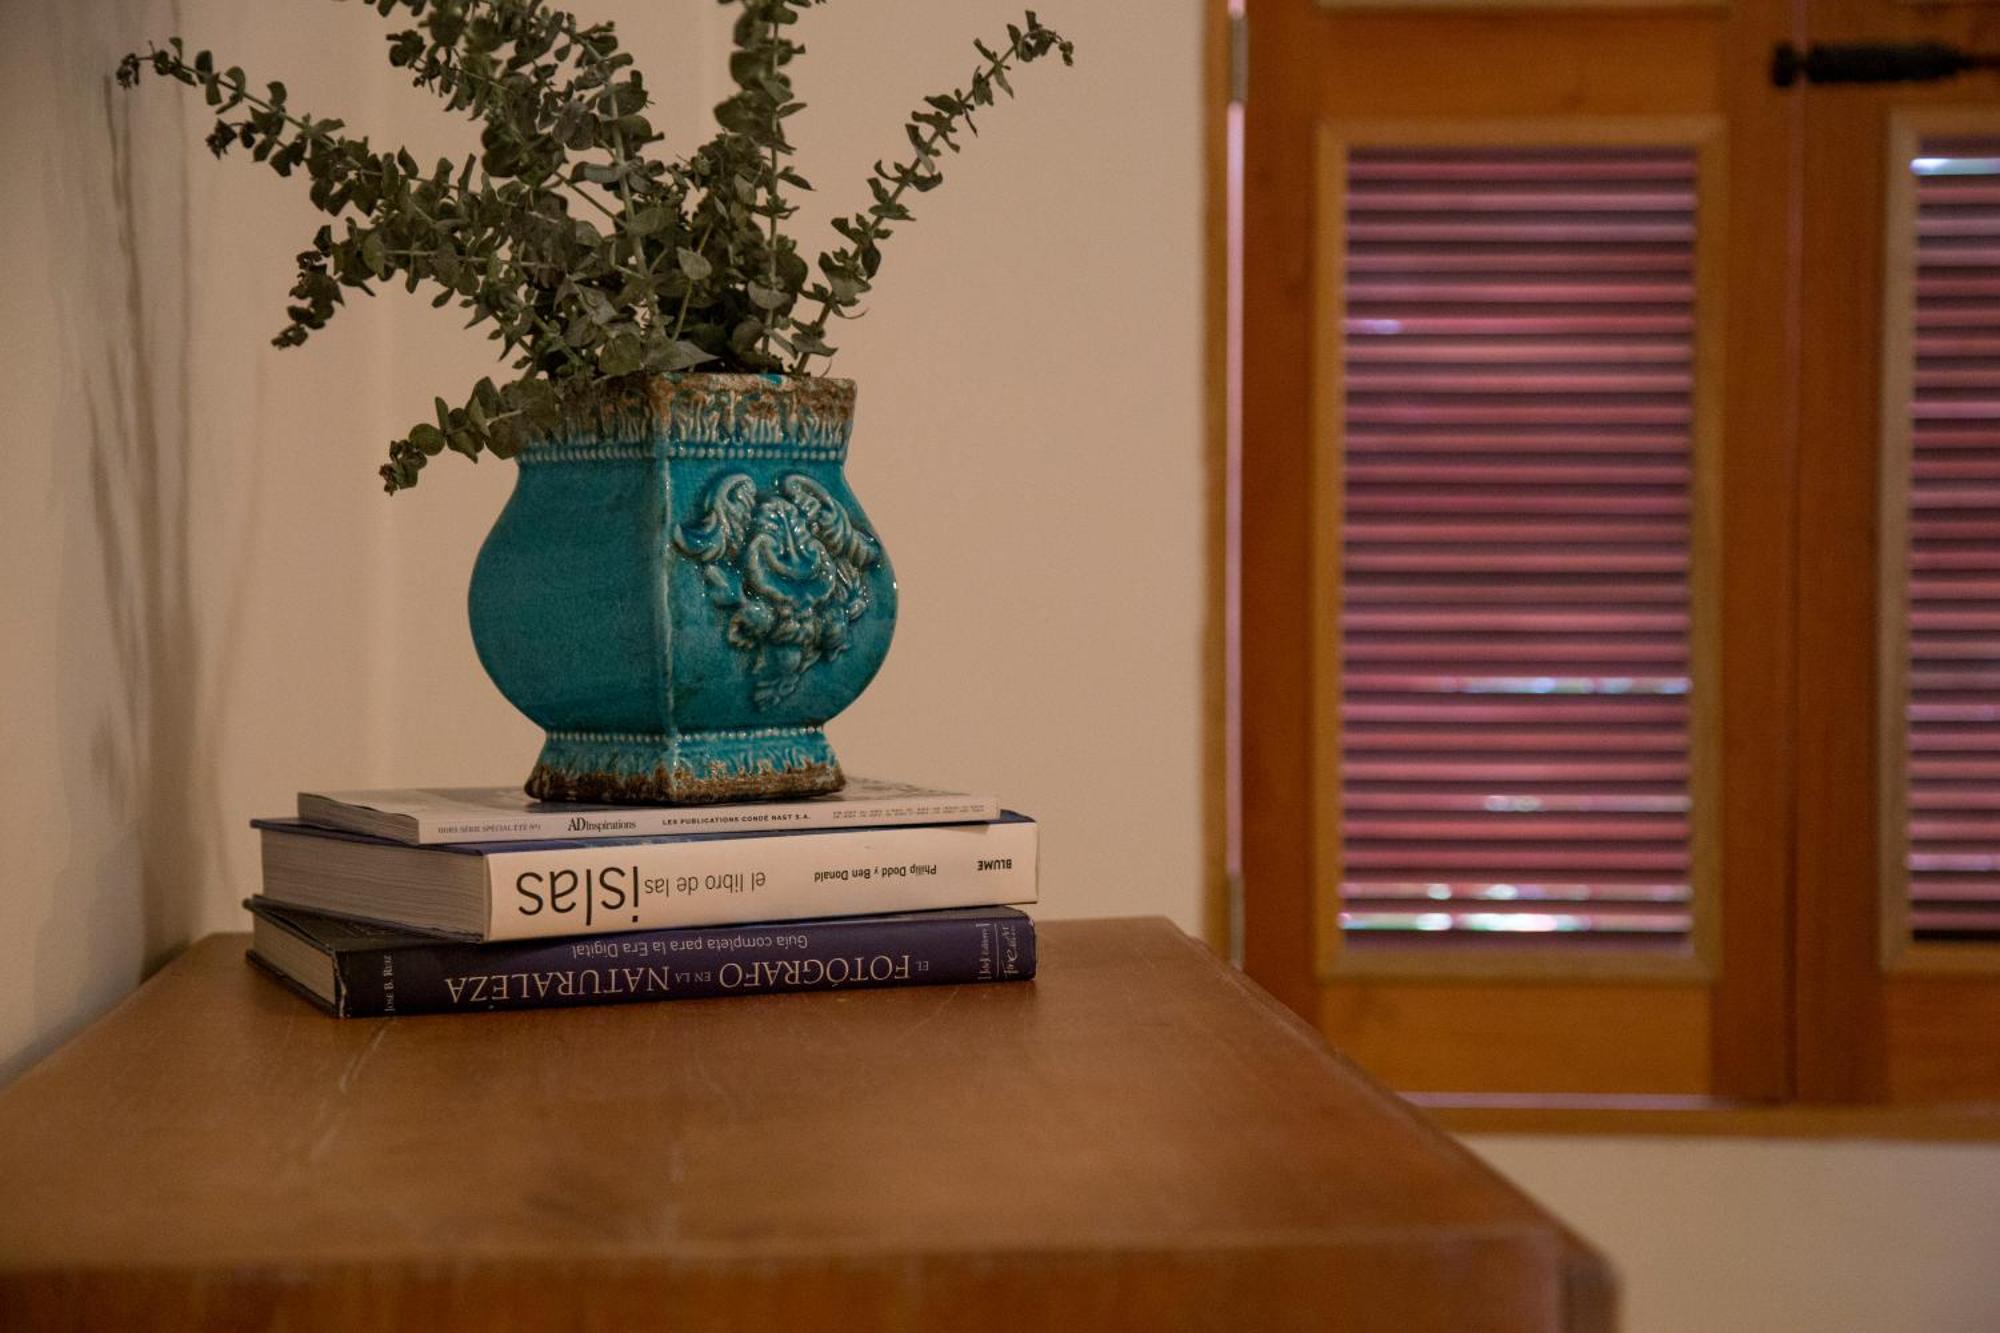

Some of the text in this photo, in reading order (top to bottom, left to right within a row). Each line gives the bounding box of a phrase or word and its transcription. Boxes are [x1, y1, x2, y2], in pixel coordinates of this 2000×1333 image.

[680, 816, 739, 825] PUBLICATIONS
[881, 865, 906, 877] Dodd
[909, 863, 937, 876] Philip
[977, 858, 1012, 871] BLUME
[814, 869, 848, 882] Donald
[851, 867, 870, 879] Ben
[516, 865, 766, 926] el libro de las islas
[572, 940, 619, 960] Digital
[623, 942, 649, 957] Era
[653, 940, 667, 956] la
[669, 935, 702, 952] para
[707, 934, 773, 951] completa
[719, 954, 911, 989] FOTÓGRAFO
[444, 965, 671, 1004] NATURALEZA
